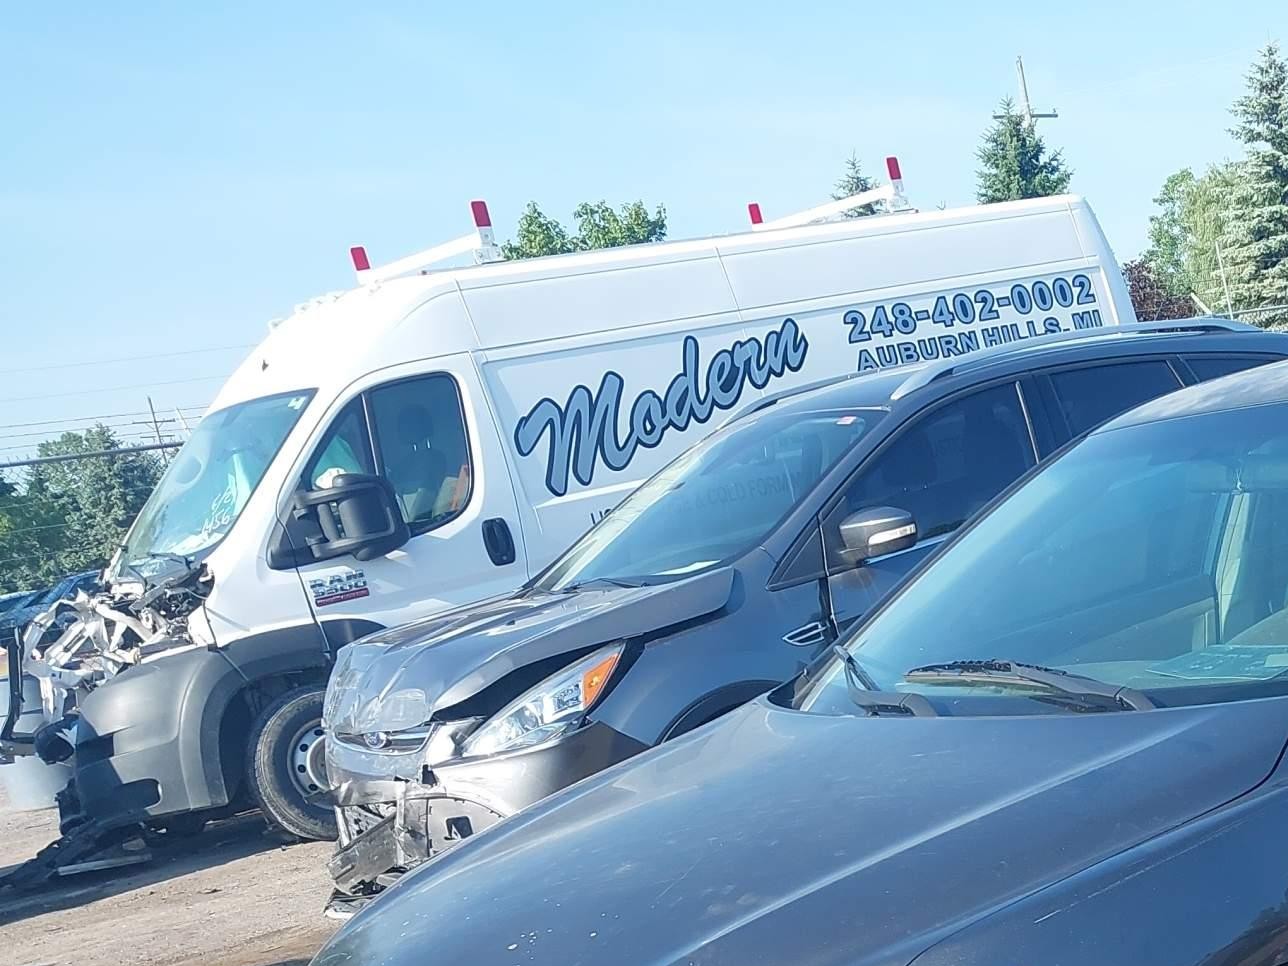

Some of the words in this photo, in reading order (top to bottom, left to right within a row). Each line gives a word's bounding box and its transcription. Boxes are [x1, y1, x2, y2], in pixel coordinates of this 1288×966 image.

[843, 274, 1096, 344] 248-402-0002
[857, 330, 979, 372] AUBURN
[981, 316, 1070, 348] HILLS
[1071, 309, 1103, 331] MI
[514, 318, 809, 497] Modern
